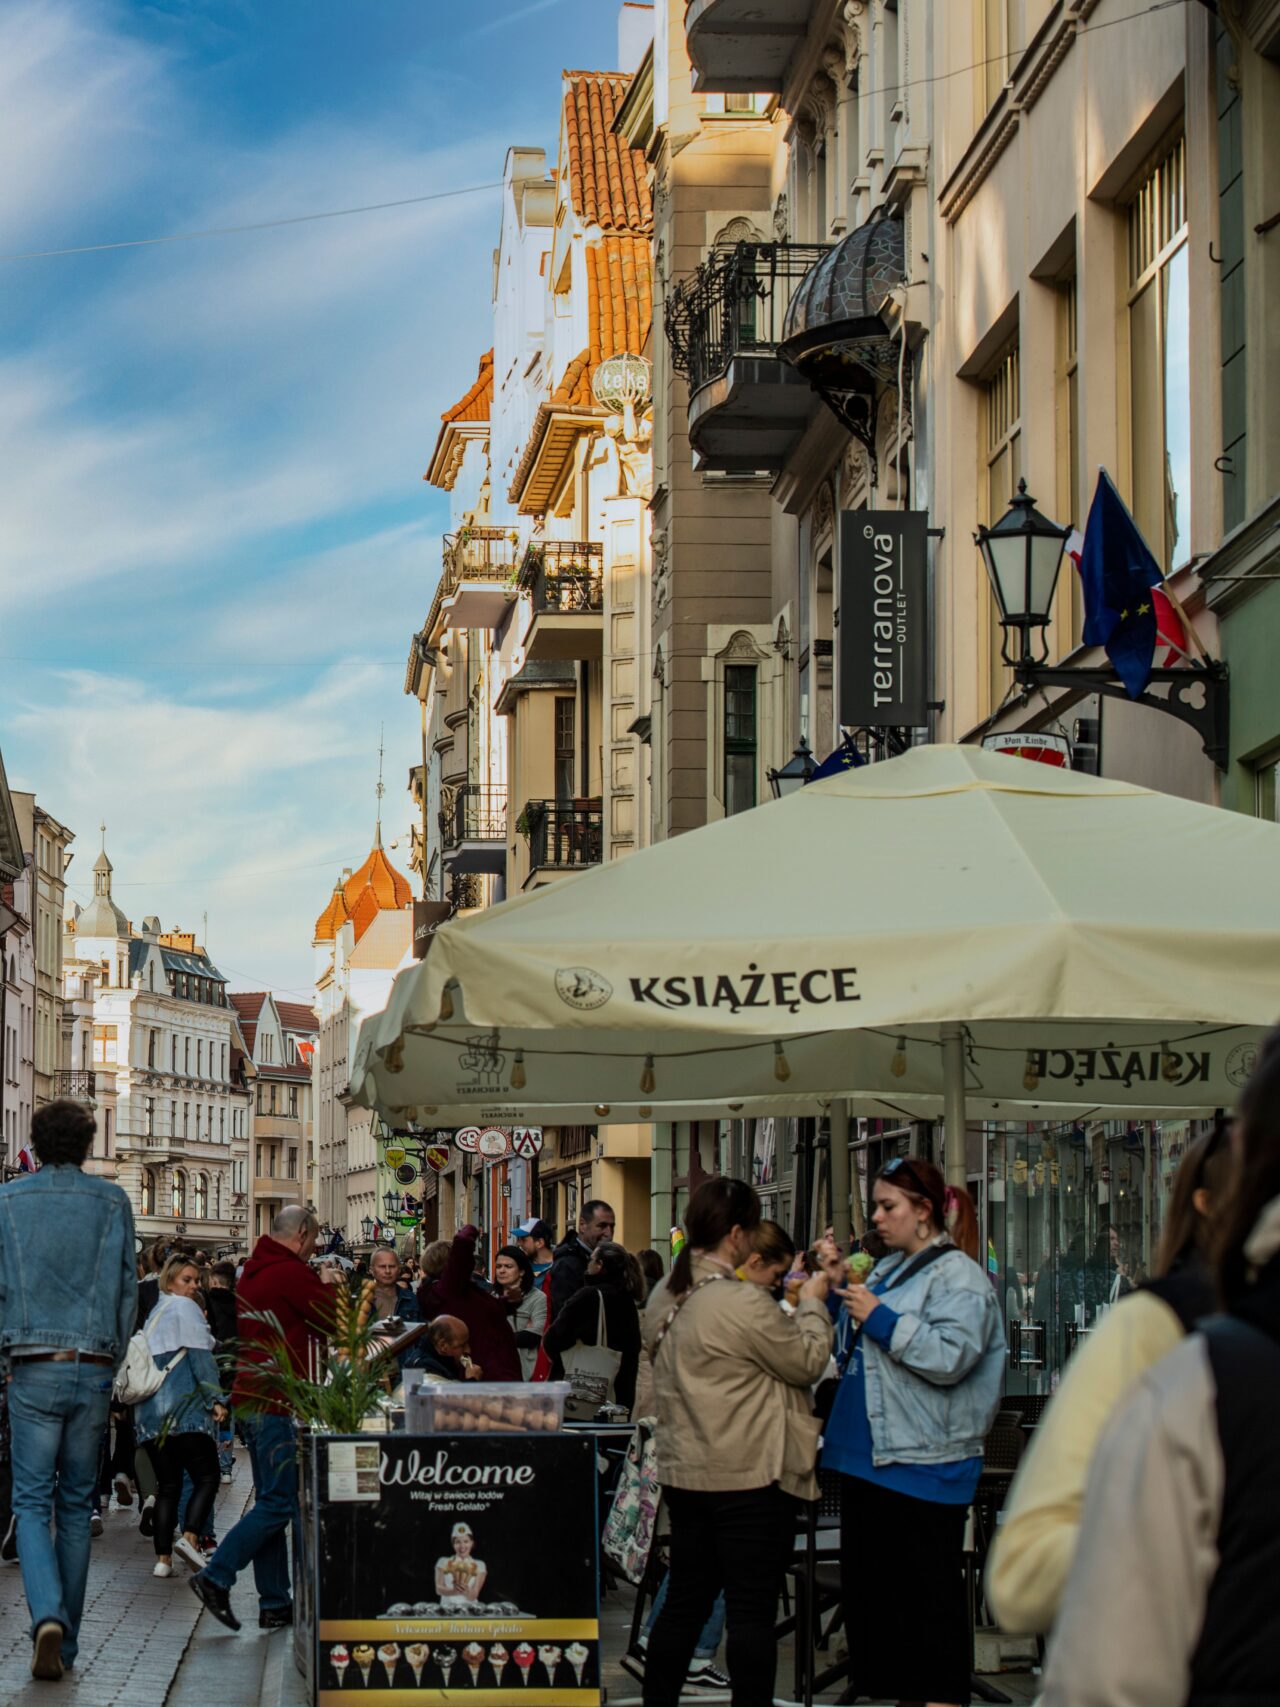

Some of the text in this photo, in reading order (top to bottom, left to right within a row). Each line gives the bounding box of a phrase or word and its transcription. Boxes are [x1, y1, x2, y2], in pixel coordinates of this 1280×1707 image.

[873, 533, 894, 707] Terranova
[896, 592, 907, 643] OUTLET
[1004, 736, 1022, 745] Von
[628, 962, 862, 1015] KSIĄŻĘCE
[377, 1449, 536, 1486] Welcome
[409, 1490, 433, 1502] Witaj
[433, 1492, 443, 1500] w
[477, 1490, 505, 1501] lodów
[428, 1501, 455, 1512] Fresh
